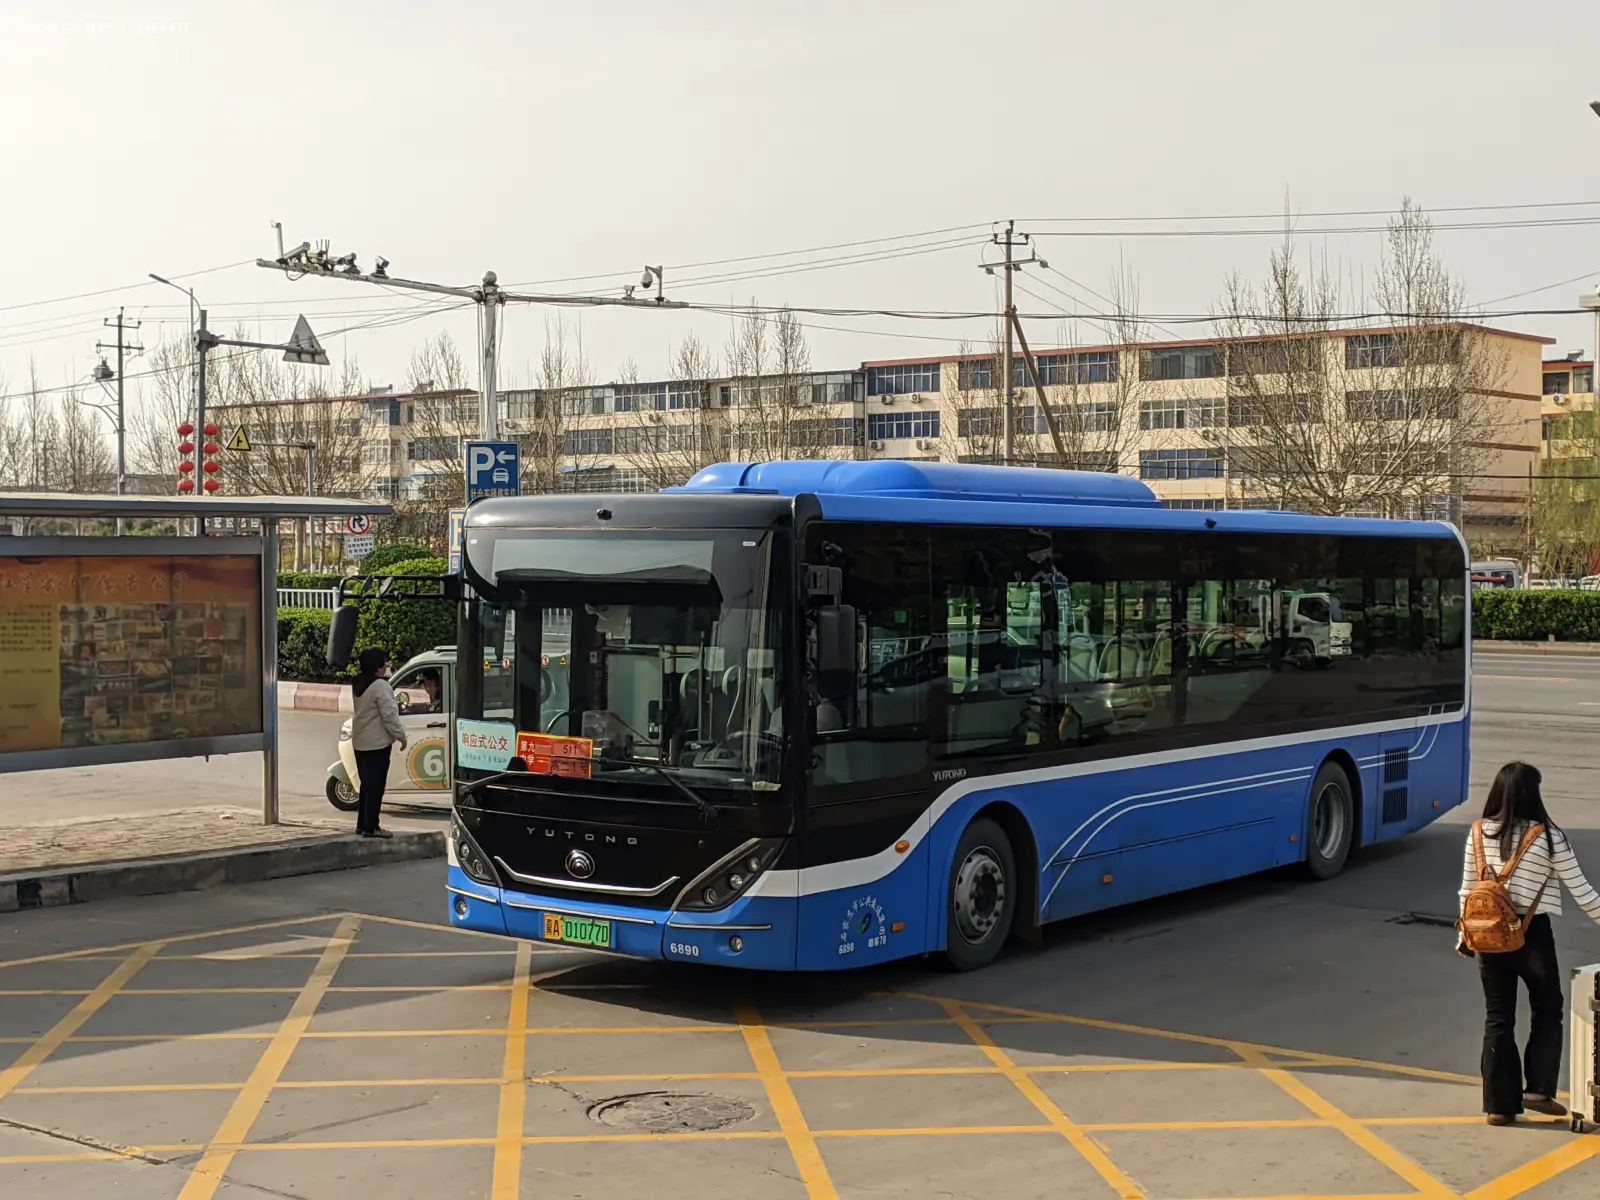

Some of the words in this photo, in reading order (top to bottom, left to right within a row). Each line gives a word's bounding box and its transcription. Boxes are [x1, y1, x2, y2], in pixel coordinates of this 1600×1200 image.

[470, 446, 495, 485] P
[461, 731, 508, 751] 响应式公交
[520, 740, 536, 752] 第九
[563, 744, 577, 754] 511
[423, 749, 444, 777] 6
[526, 826, 638, 845] YUTONG
[670, 942, 699, 956] 6890
[838, 942, 854, 954] 6890
